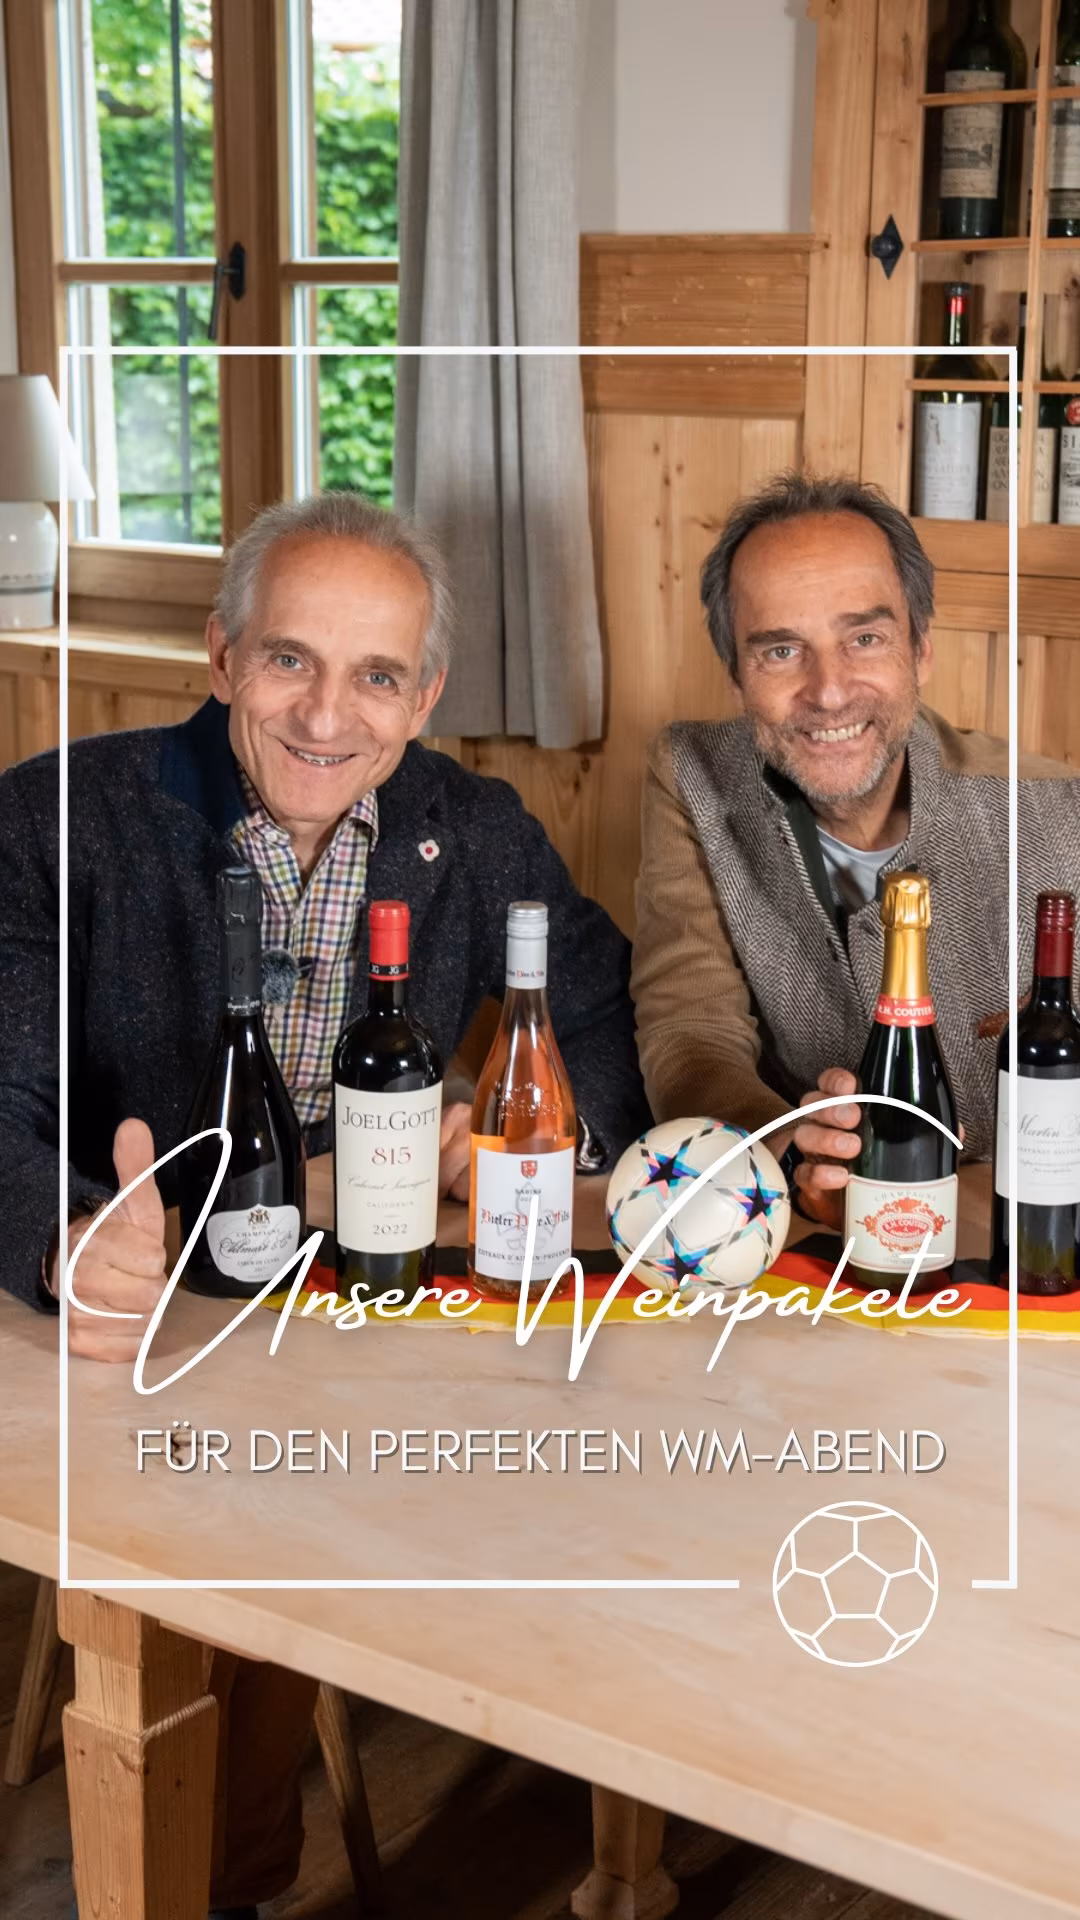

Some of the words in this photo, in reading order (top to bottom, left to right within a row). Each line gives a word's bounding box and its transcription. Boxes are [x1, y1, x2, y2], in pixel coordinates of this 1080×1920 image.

[389, 965, 400, 975] JG
[371, 1146, 412, 1166] 815
[372, 1223, 408, 1236] 2022
